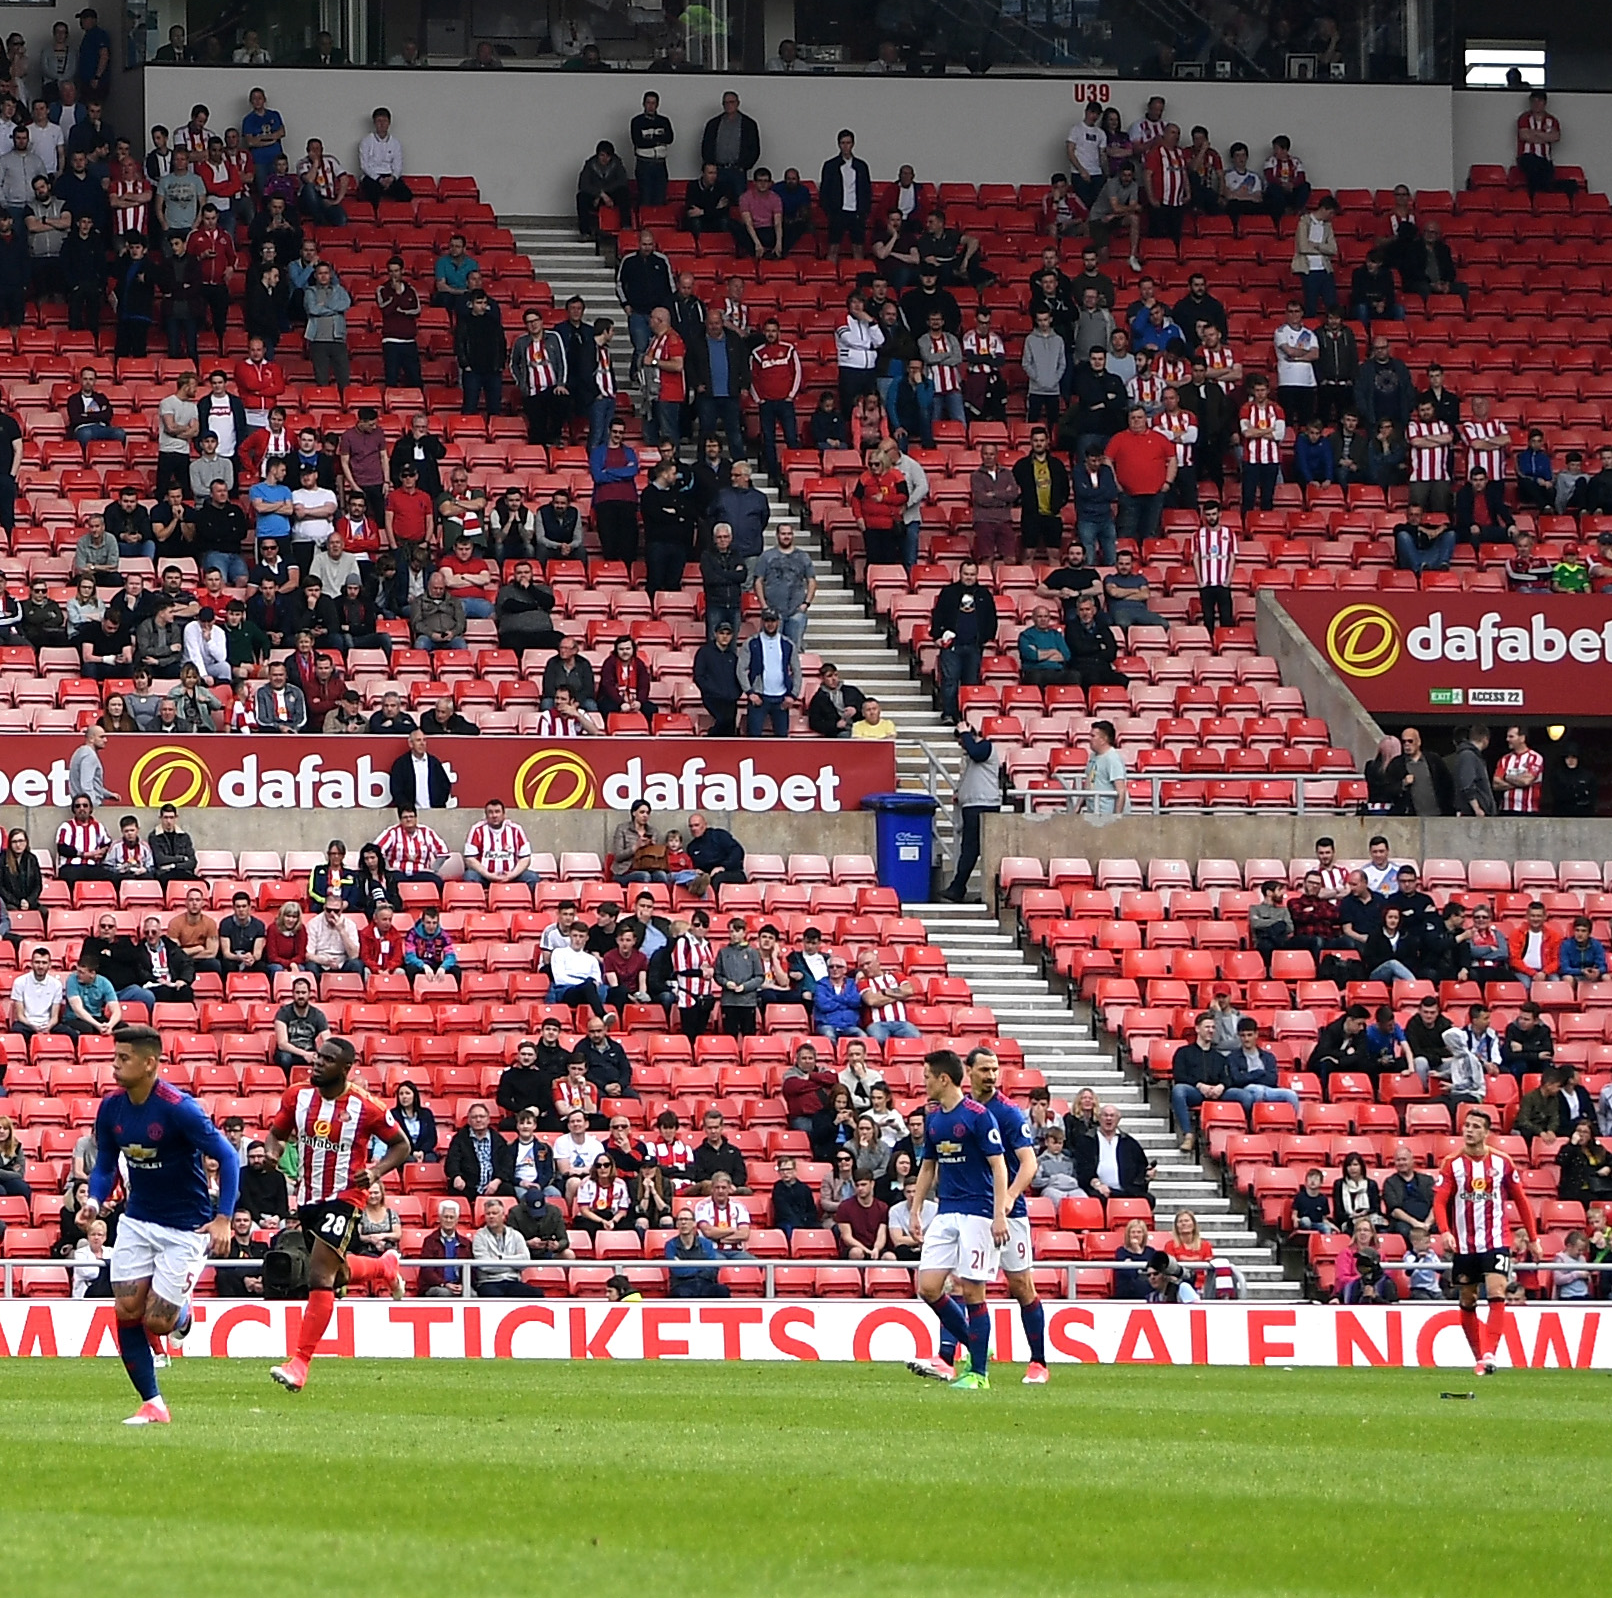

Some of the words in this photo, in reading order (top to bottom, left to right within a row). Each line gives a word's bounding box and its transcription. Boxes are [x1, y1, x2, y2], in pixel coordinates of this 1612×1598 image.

[1074, 83, 1110, 103] U39
[1431, 691, 1451, 702] EXIT
[1471, 691, 1505, 702] ACCESS
[1507, 691, 1520, 702] 22
[602, 756, 841, 811] dafabet
[321, 1213, 346, 1236] 28
[971, 1249, 985, 1270] 21
[1017, 1242, 1026, 1260] 9
[1495, 1254, 1509, 1272] 21
[181, 1271, 194, 1294] 5
[389, 1304, 819, 1361] TICKETS
[1048, 1306, 1295, 1367] SALE
[1336, 1309, 1601, 1369] NOW
